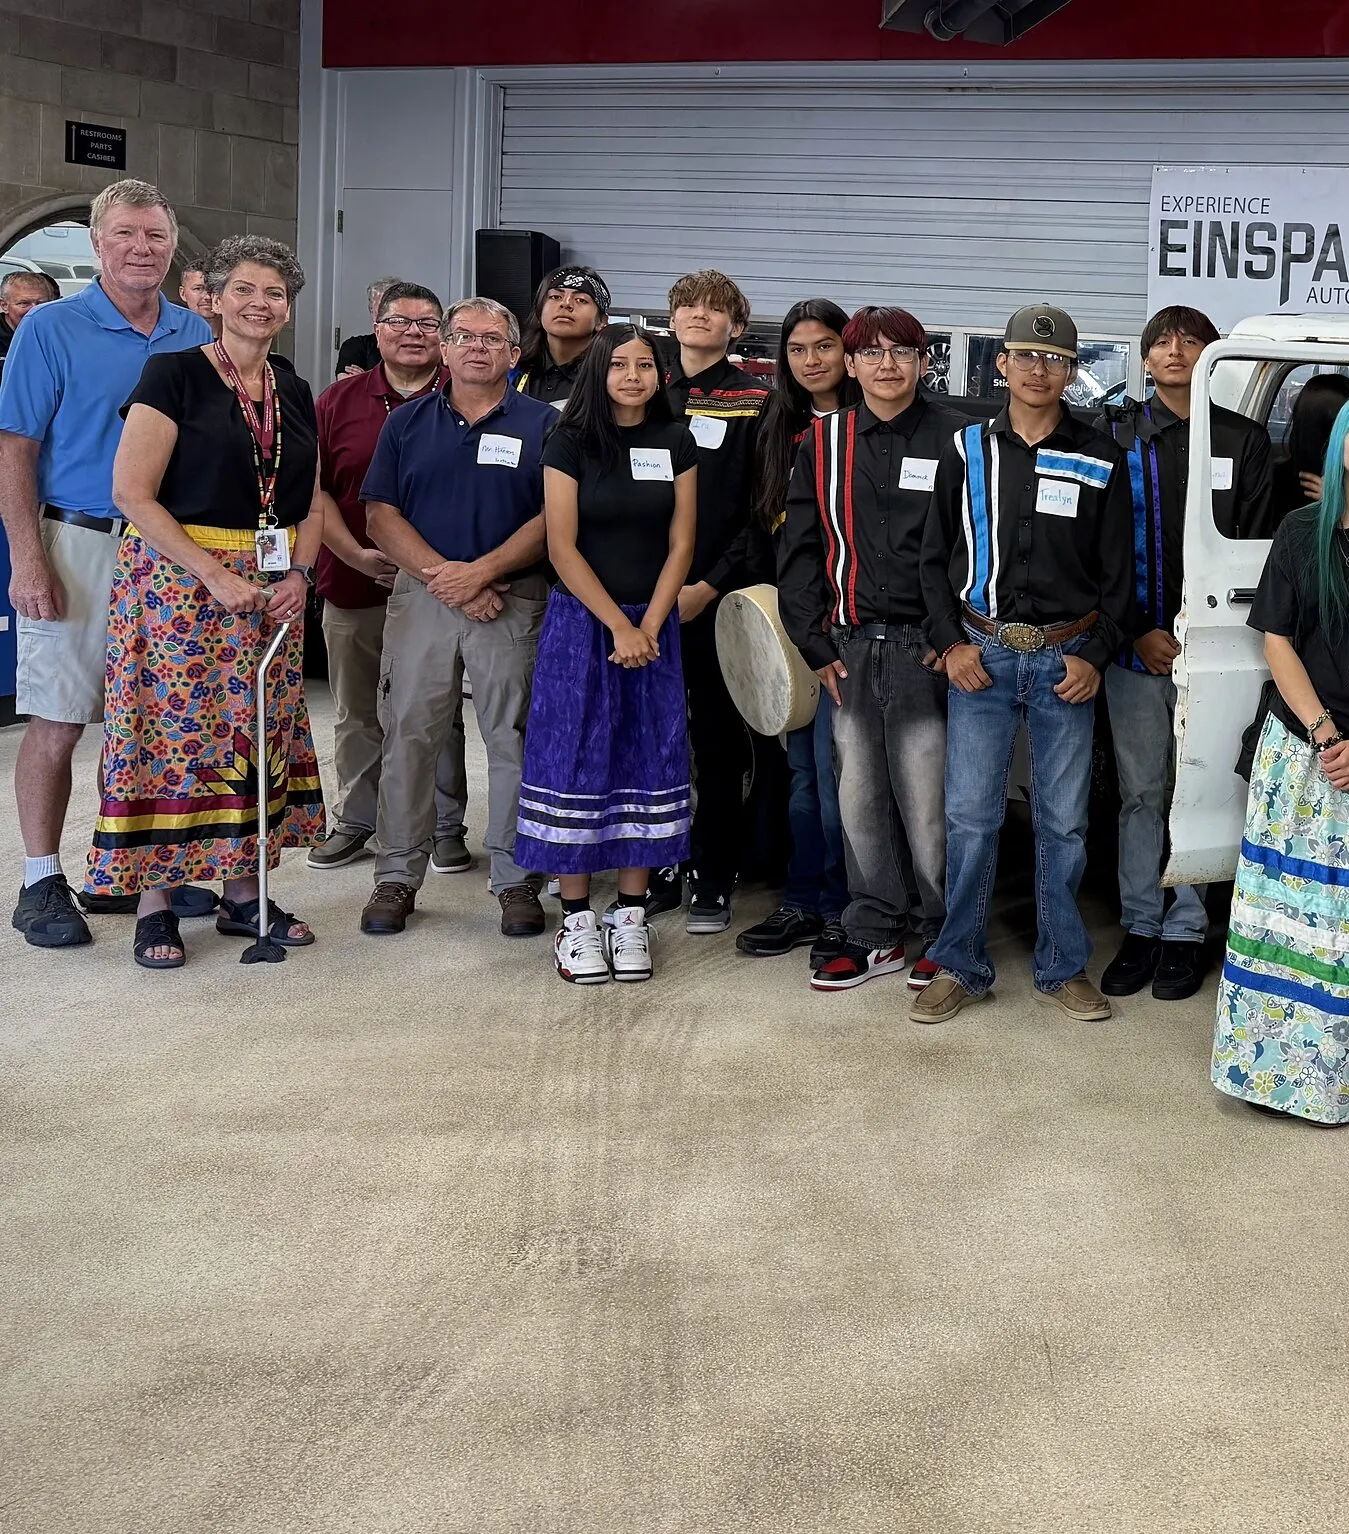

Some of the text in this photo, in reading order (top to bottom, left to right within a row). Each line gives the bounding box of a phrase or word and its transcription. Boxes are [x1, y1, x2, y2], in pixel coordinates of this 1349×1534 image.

[80, 129, 123, 142] RESTROOMS
[90, 141, 113, 151] PARTS
[86, 152, 116, 163] CASHIER
[1161, 195, 1271, 215] EXPERIENCE
